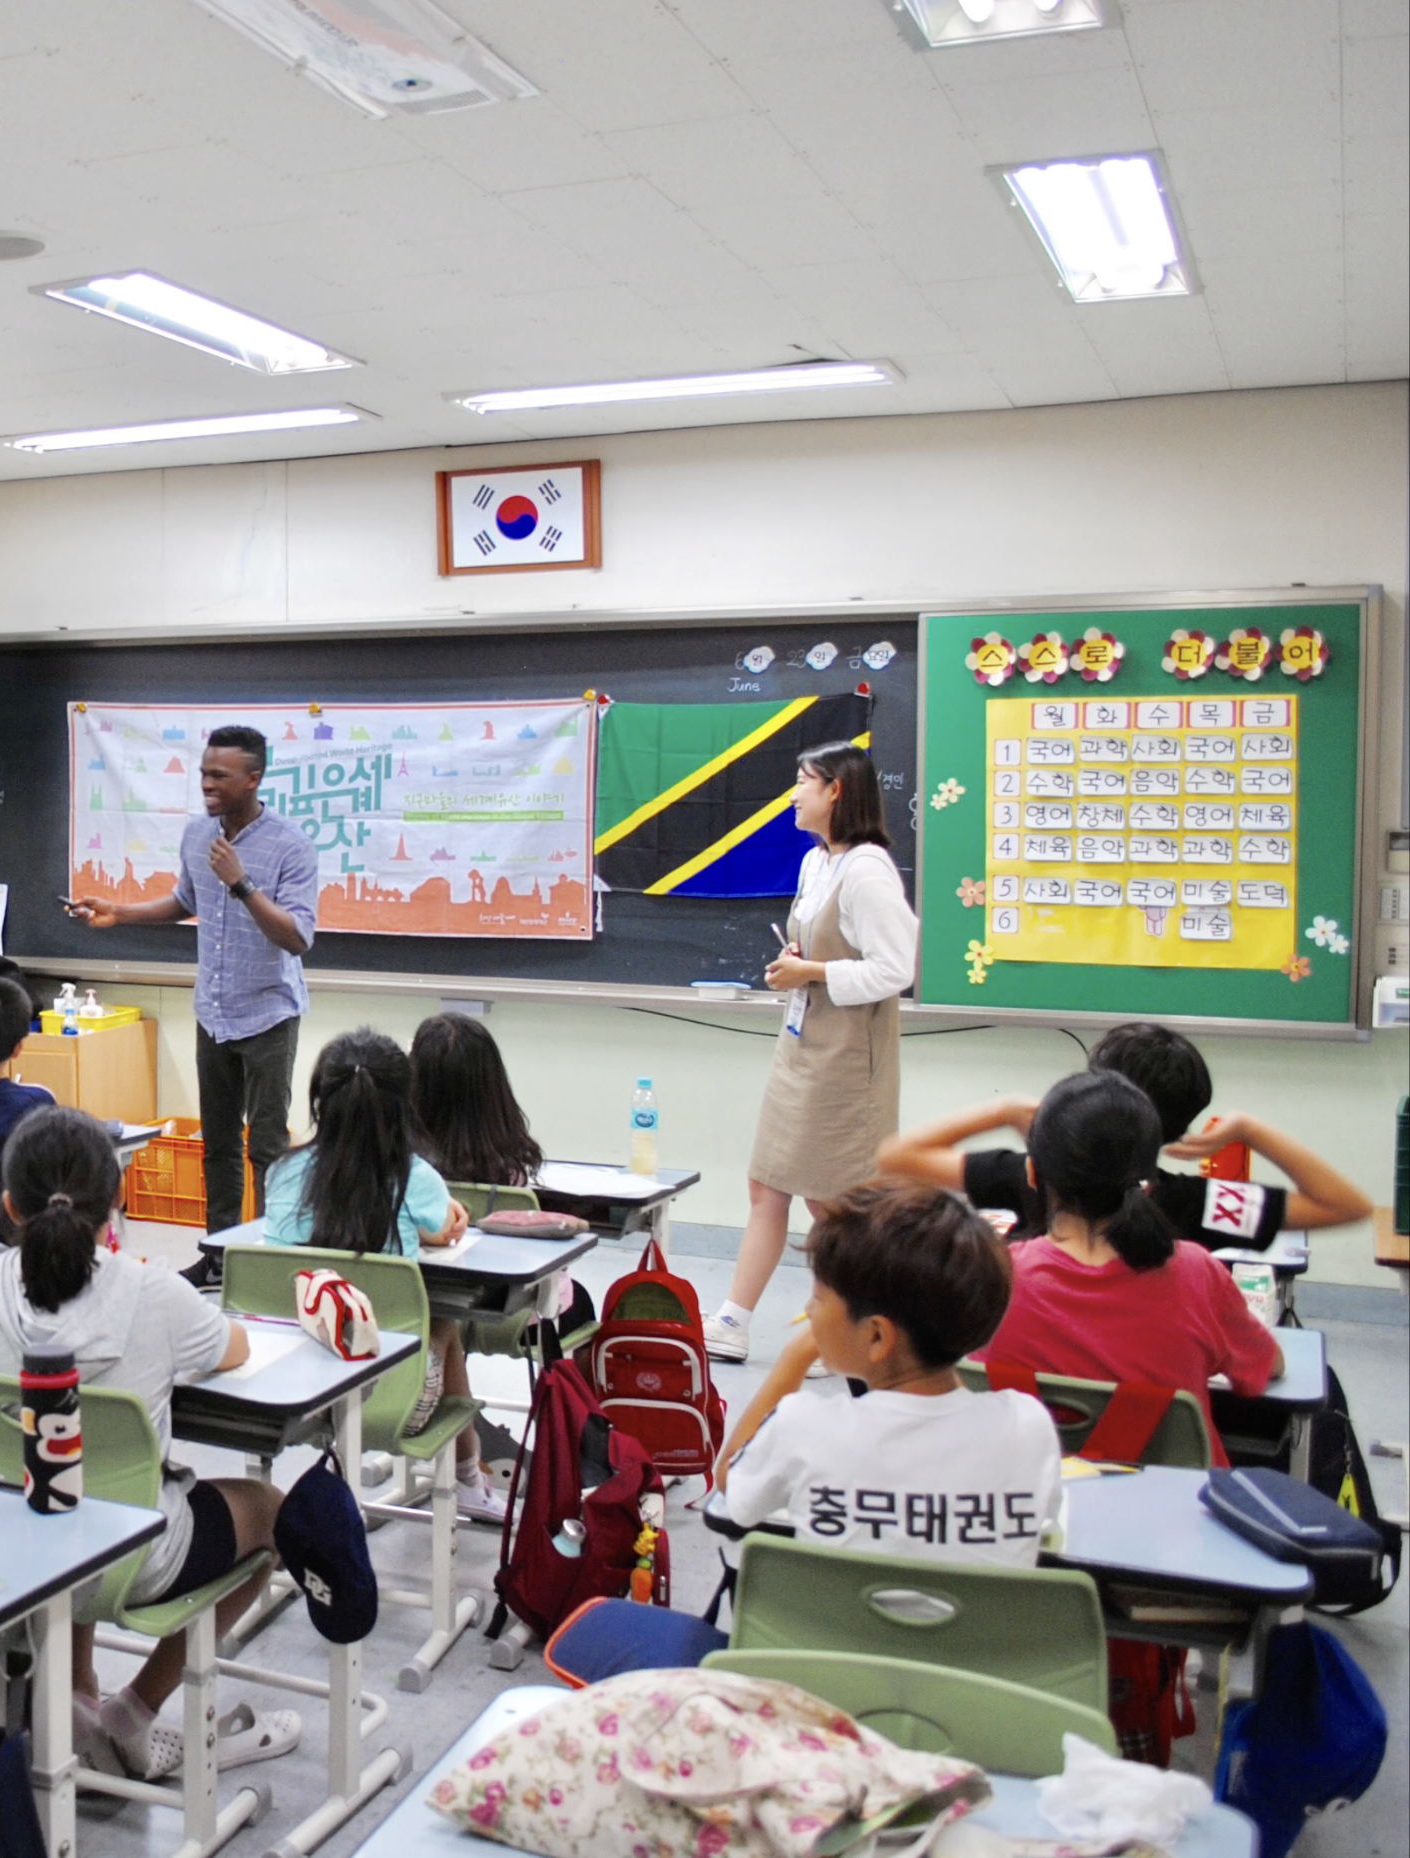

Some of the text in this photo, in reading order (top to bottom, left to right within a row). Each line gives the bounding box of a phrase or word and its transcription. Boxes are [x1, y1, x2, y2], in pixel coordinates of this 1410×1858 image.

[980, 641, 1314, 668] 스스로 더불어
[726, 677, 761, 692] June
[1043, 702, 1275, 727] 월 화 수 목 금
[275, 743, 393, 766] Deep-rooted World Heritage
[1004, 736, 1290, 761] 1 국어 과학 사회 국어 사회
[1001, 769, 1290, 794] 2 수학 국어 음악 수학 국어
[1000, 805, 1288, 827] 3 영어 창체 수학 영어 체육
[999, 836, 1289, 861] 4 체육 음악 과학 과학 수학
[999, 879, 1285, 905] 5 사회 국어 국어 미술 도덕
[998, 911, 1229, 937] 6 미술
[807, 1485, 1040, 1545] 충무태권도
